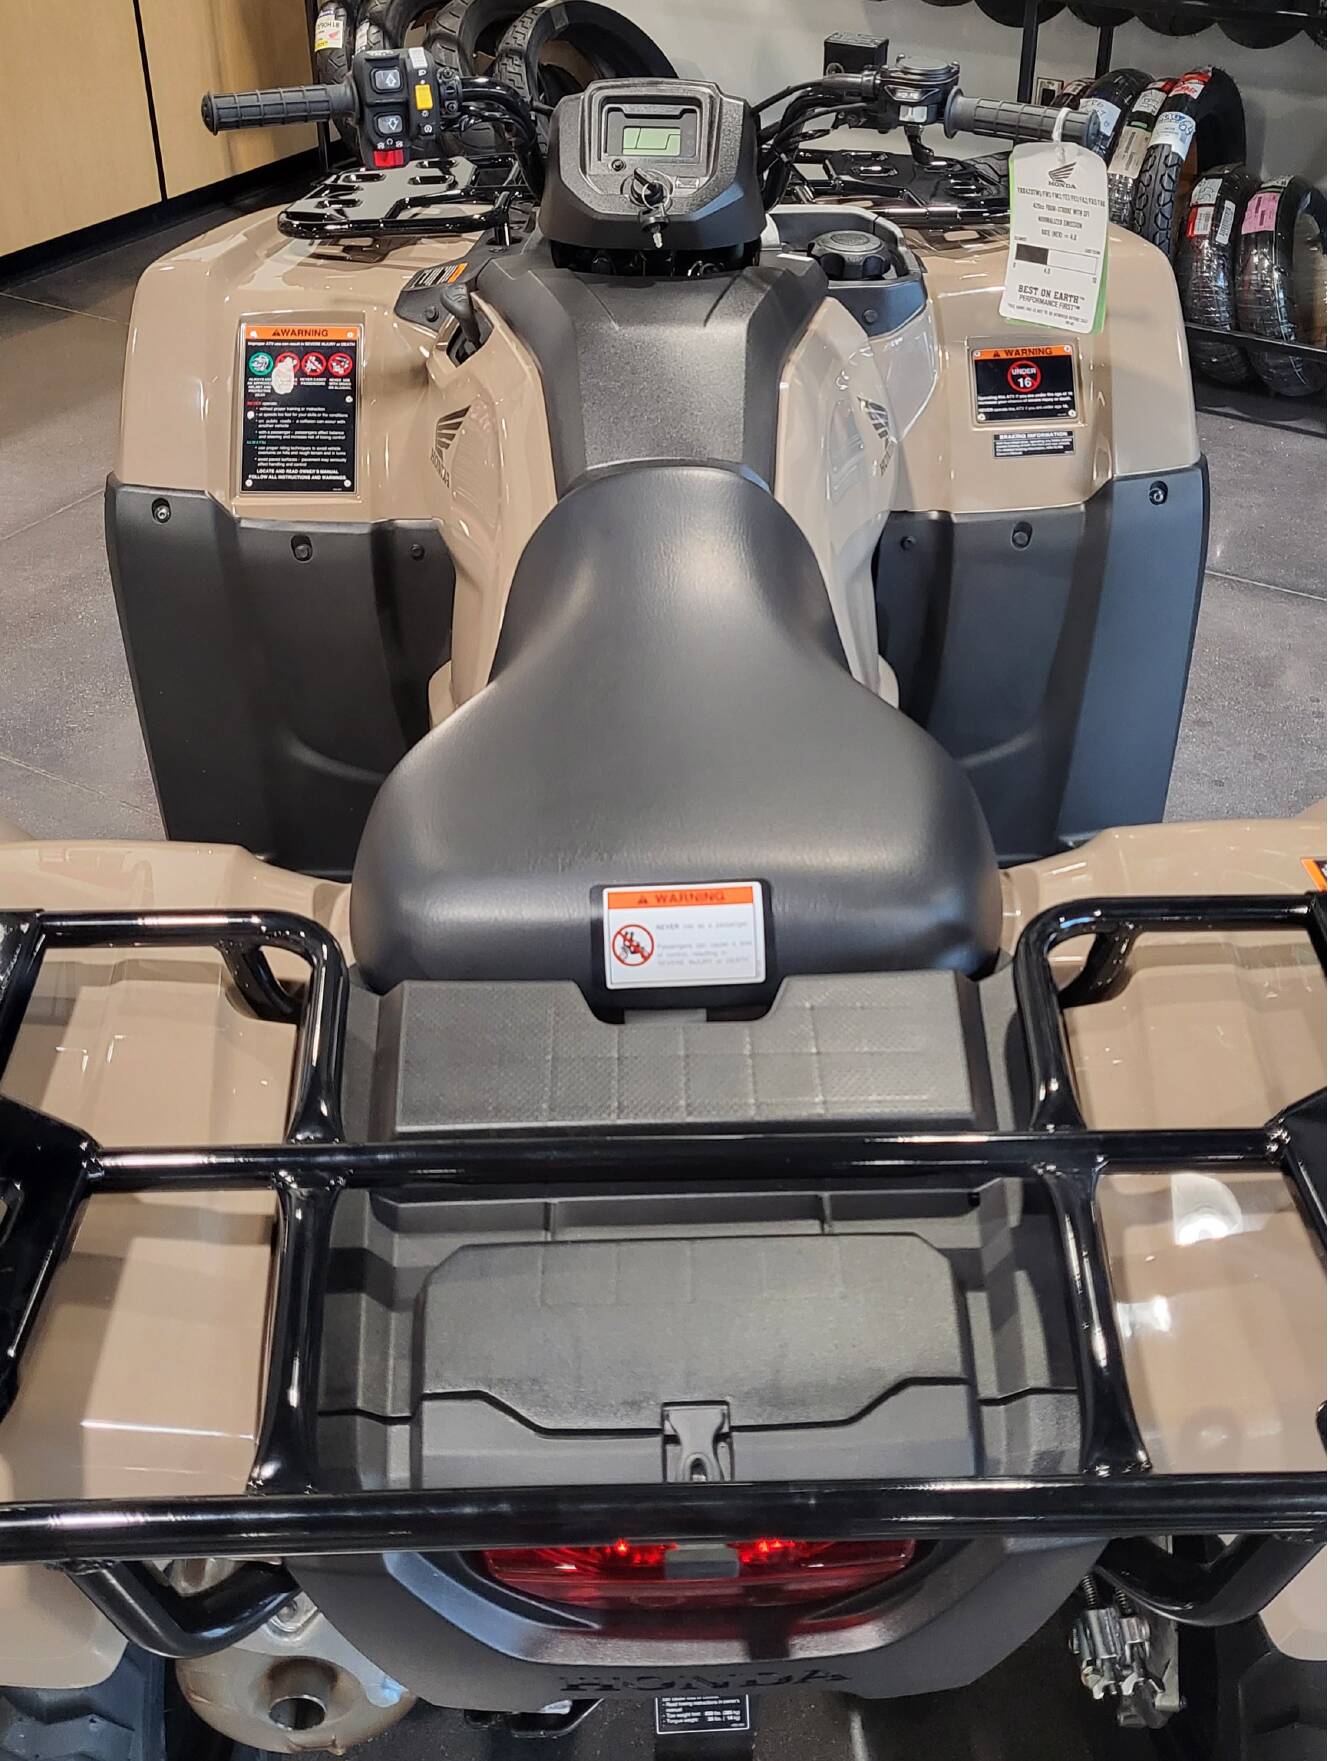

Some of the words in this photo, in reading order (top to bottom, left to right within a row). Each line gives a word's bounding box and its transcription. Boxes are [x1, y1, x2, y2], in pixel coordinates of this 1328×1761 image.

[1048, 181, 1077, 189] HONDA
[1018, 284, 1039, 296] BEST
[1040, 289, 1052, 298] ON
[1019, 294, 1058, 307] PERFORMANCE
[280, 329, 329, 337] WARNING
[1004, 347, 1053, 357] WARNING
[1011, 367, 1037, 375] UNDER
[1017, 377, 1032, 388] 16
[654, 891, 727, 904] WARNING
[558, 1669, 853, 1692] HONDA
